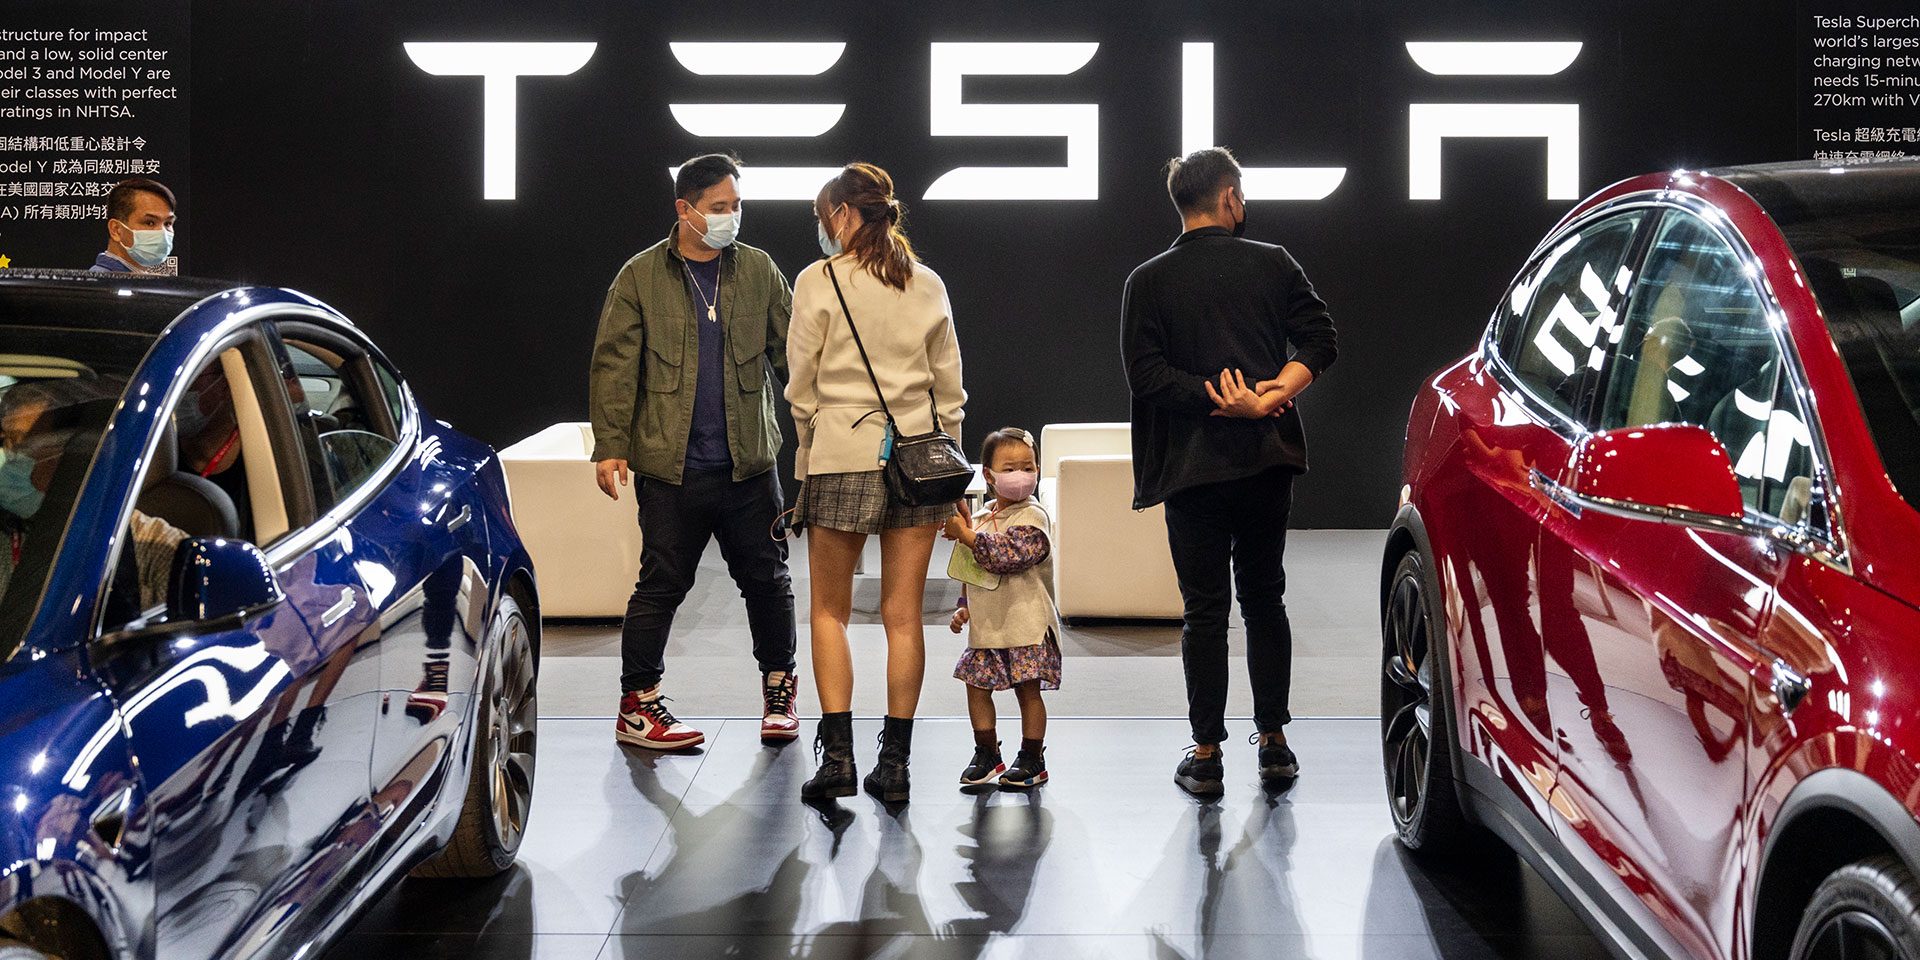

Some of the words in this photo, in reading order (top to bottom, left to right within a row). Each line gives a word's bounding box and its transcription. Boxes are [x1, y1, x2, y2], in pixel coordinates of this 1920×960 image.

[1813, 15, 1852, 28] Tesla
[1856, 15, 1920, 31] Superch
[0, 28, 64, 41] tructure
[68, 28, 91, 41] for
[95, 28, 148, 43] impact
[1873, 34, 1920, 50] larges
[30, 50, 39, 60] a
[45, 47, 74, 62] low,
[78, 47, 114, 60] solid
[119, 48, 168, 60] center
[1813, 54, 1881, 70] charging
[32, 67, 41, 79] 3
[46, 67, 75, 79] and
[80, 67, 126, 79] Model
[131, 67, 143, 79] Y
[146, 69, 171, 79] are
[1813, 74, 1860, 87] needs
[1, 86, 21, 98] eir
[25, 86, 79, 98] classes
[83, 86, 117, 98] with
[121, 86, 178, 101] perfect
[1813, 94, 1866, 106] 270km
[1871, 93, 1904, 106] with
[0, 105, 53, 120] ratings
[57, 105, 71, 118] in
[76, 105, 135, 118] NHTSA.
[403, 42, 1584, 200] TESLA
[1813, 128, 1851, 141] Tesla
[1855, 127, 1920, 142] 超級充電
[37, 160, 48, 173] Y
[52, 159, 160, 174] 成為同級別最安
[0, 182, 119, 197] 美國國家公路交
